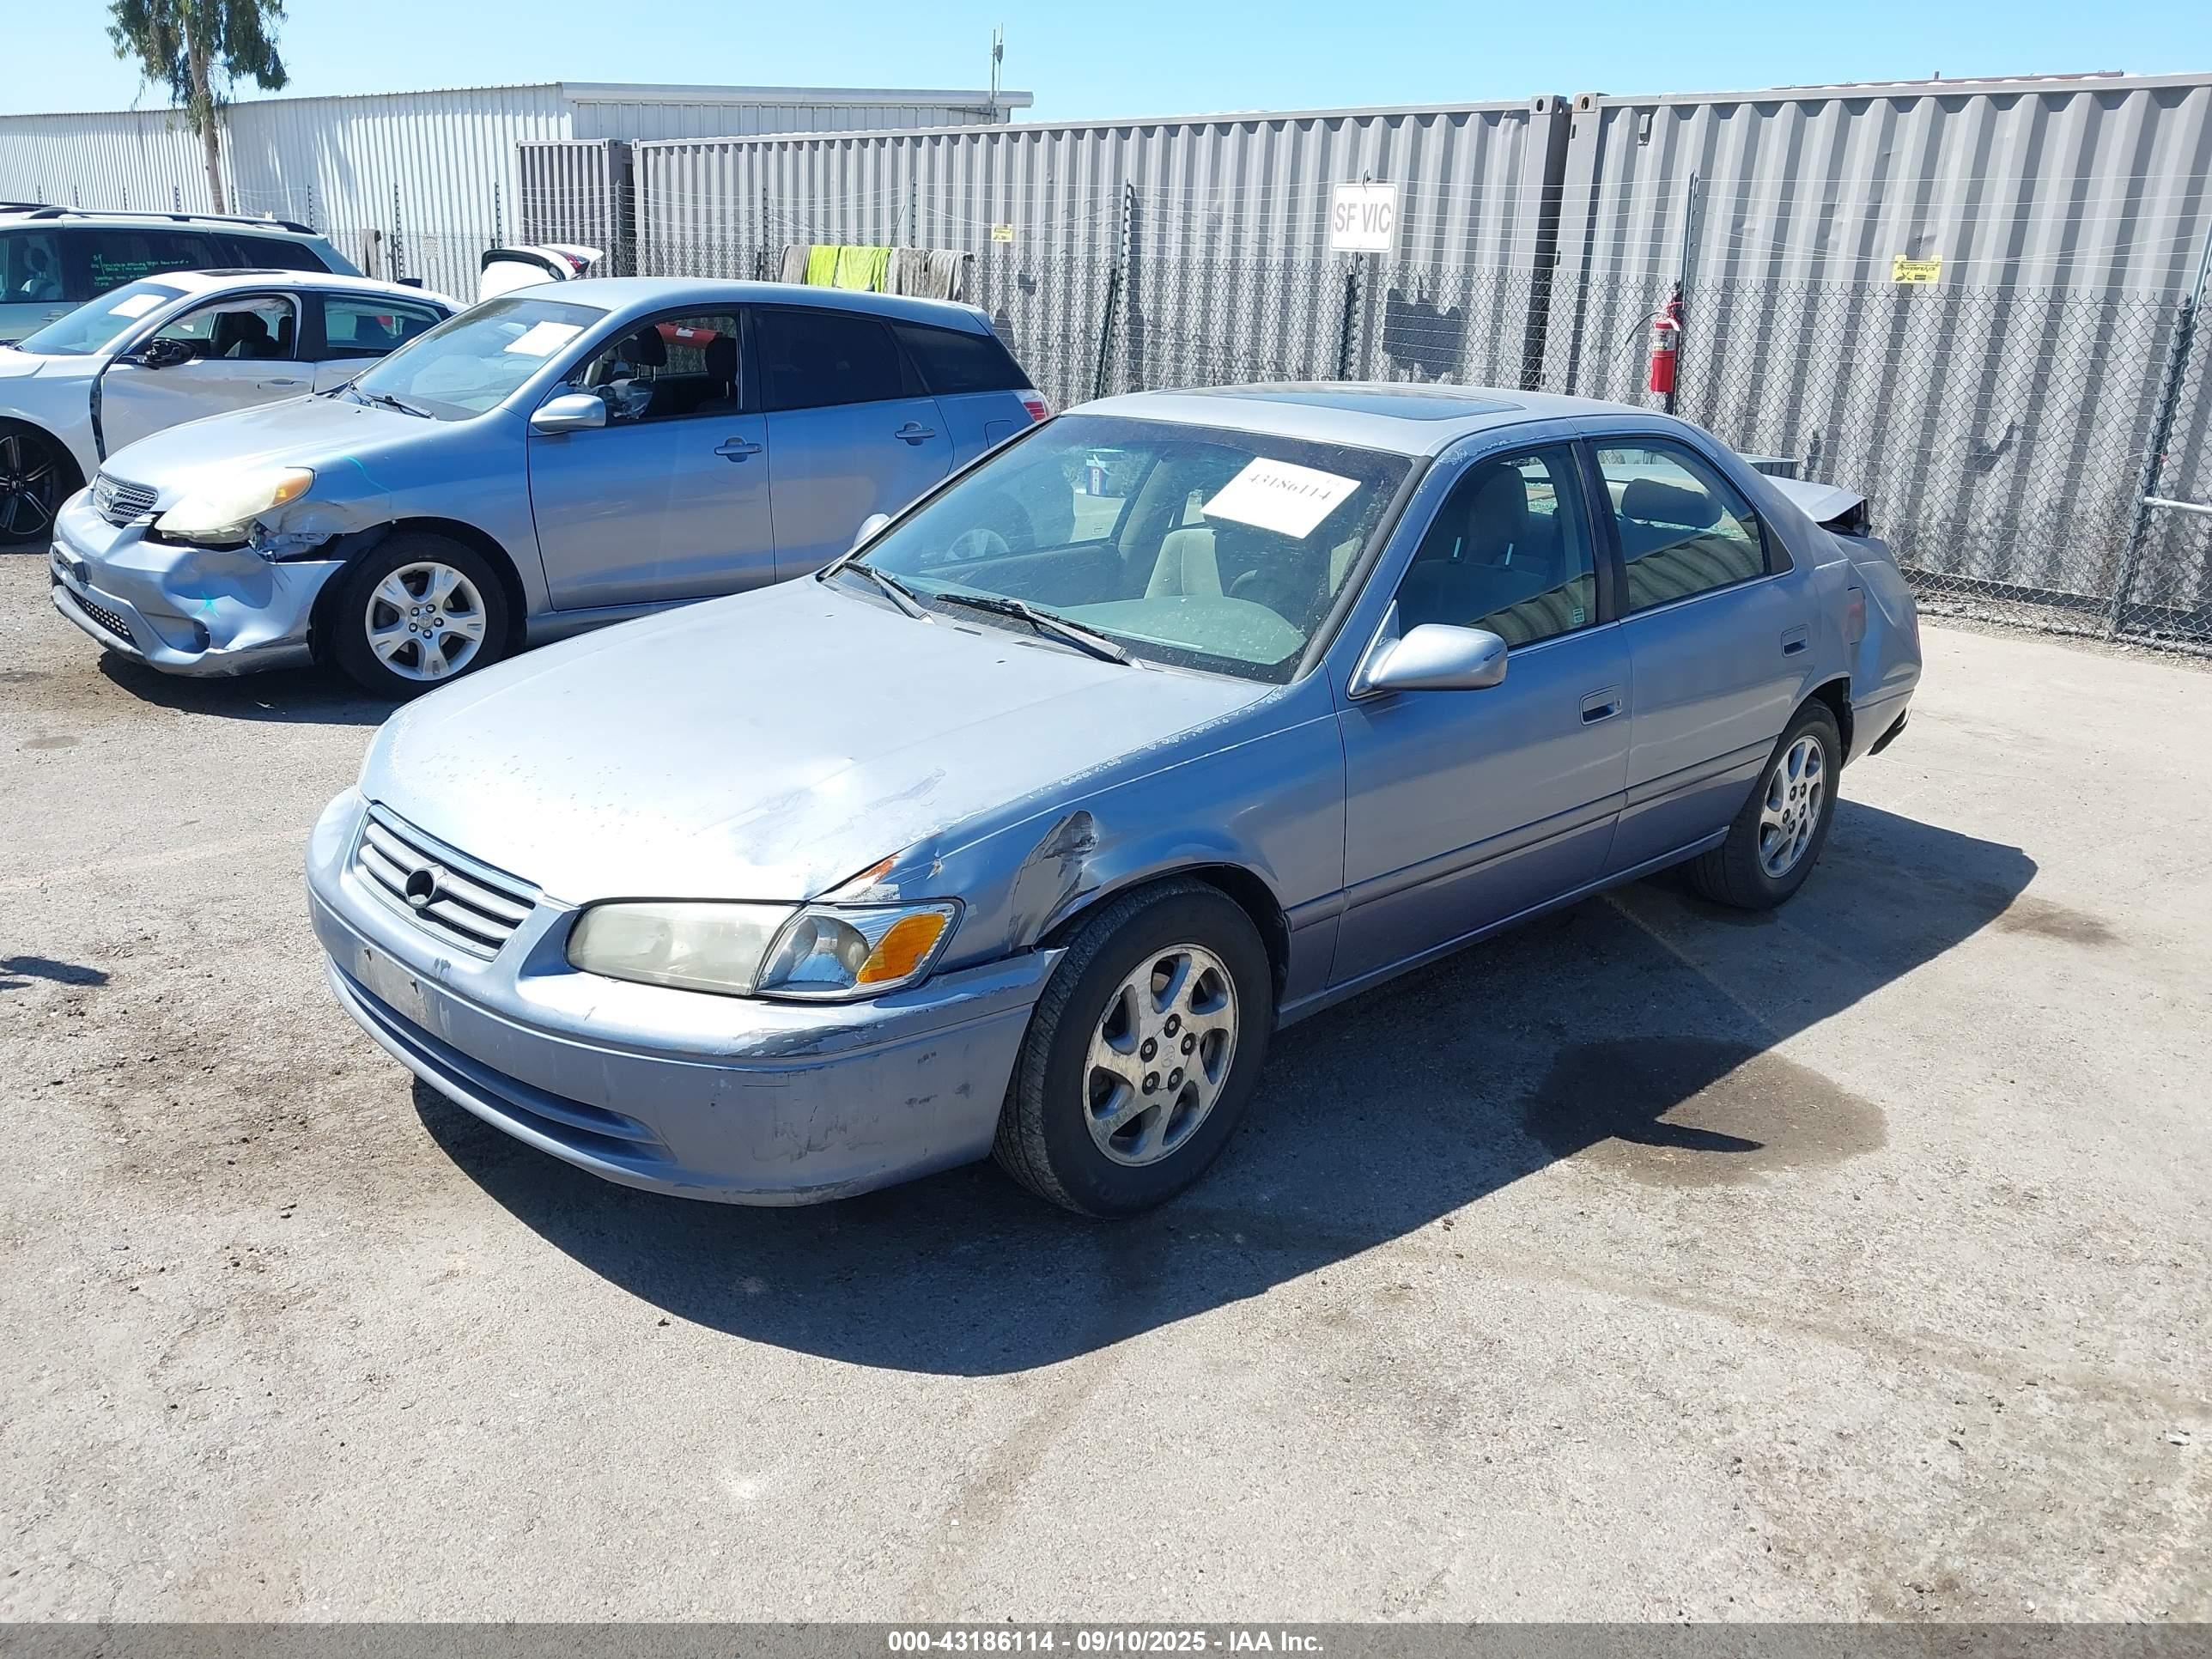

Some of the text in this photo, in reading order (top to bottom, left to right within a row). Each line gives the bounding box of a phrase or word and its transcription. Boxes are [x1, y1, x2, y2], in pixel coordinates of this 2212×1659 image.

[1334, 202, 1393, 234] SF VIC
[1248, 472, 1334, 501] 43186114
